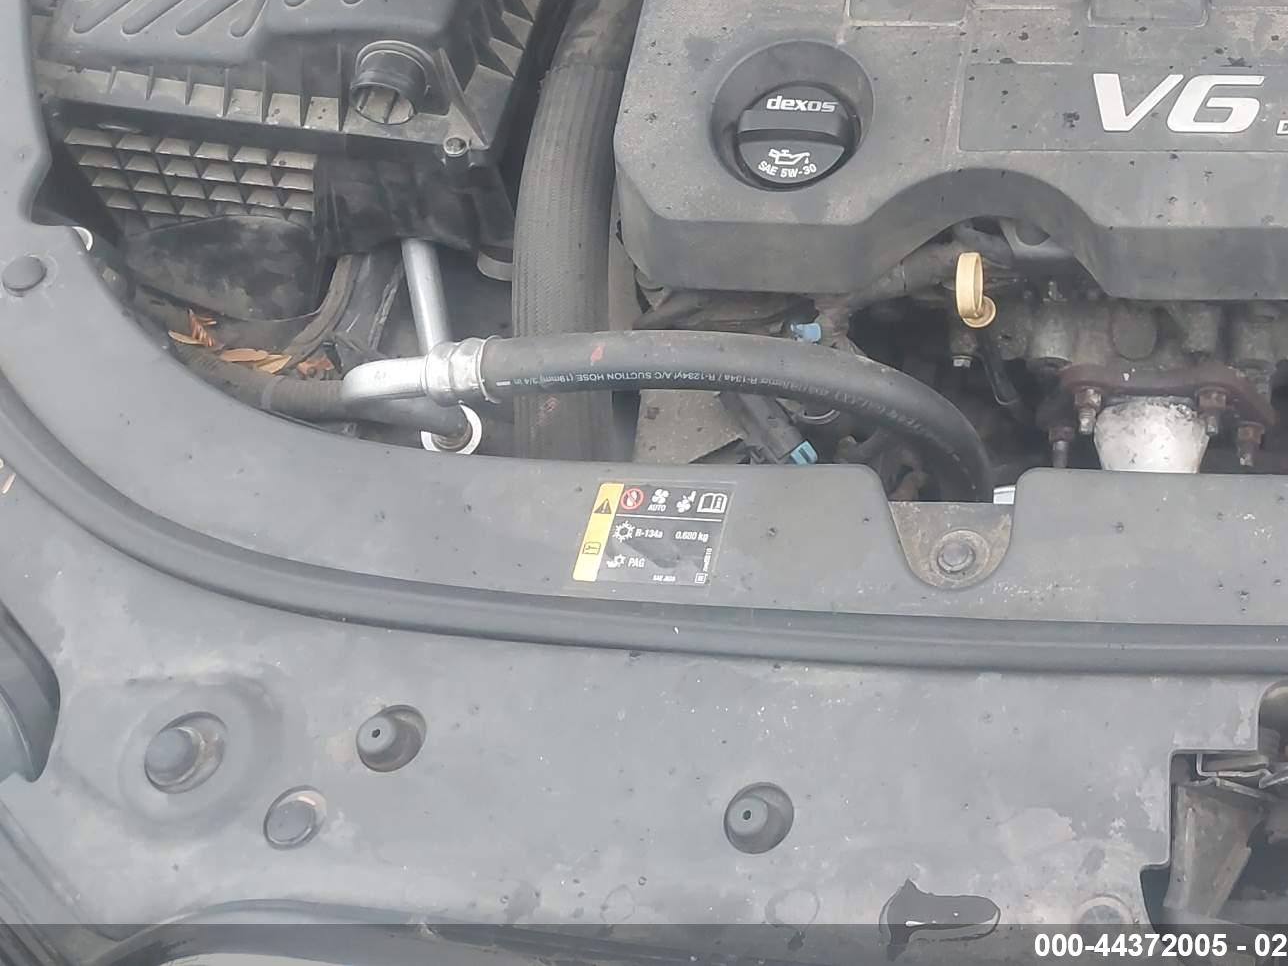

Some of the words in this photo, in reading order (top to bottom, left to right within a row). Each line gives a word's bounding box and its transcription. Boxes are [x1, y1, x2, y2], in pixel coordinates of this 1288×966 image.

[766, 95, 839, 113] dexos
[1092, 73, 1265, 133] V6
[758, 161, 778, 176] SAE
[780, 164, 817, 178] 5W-30
[575, 372, 605, 382] HOSE
[607, 371, 652, 381] SUCTION
[654, 371, 673, 380] A/C
[648, 504, 666, 512] AUTO
[635, 528, 663, 538] R-134a
[698, 532, 709, 543] kg
[628, 557, 646, 568] PAG
